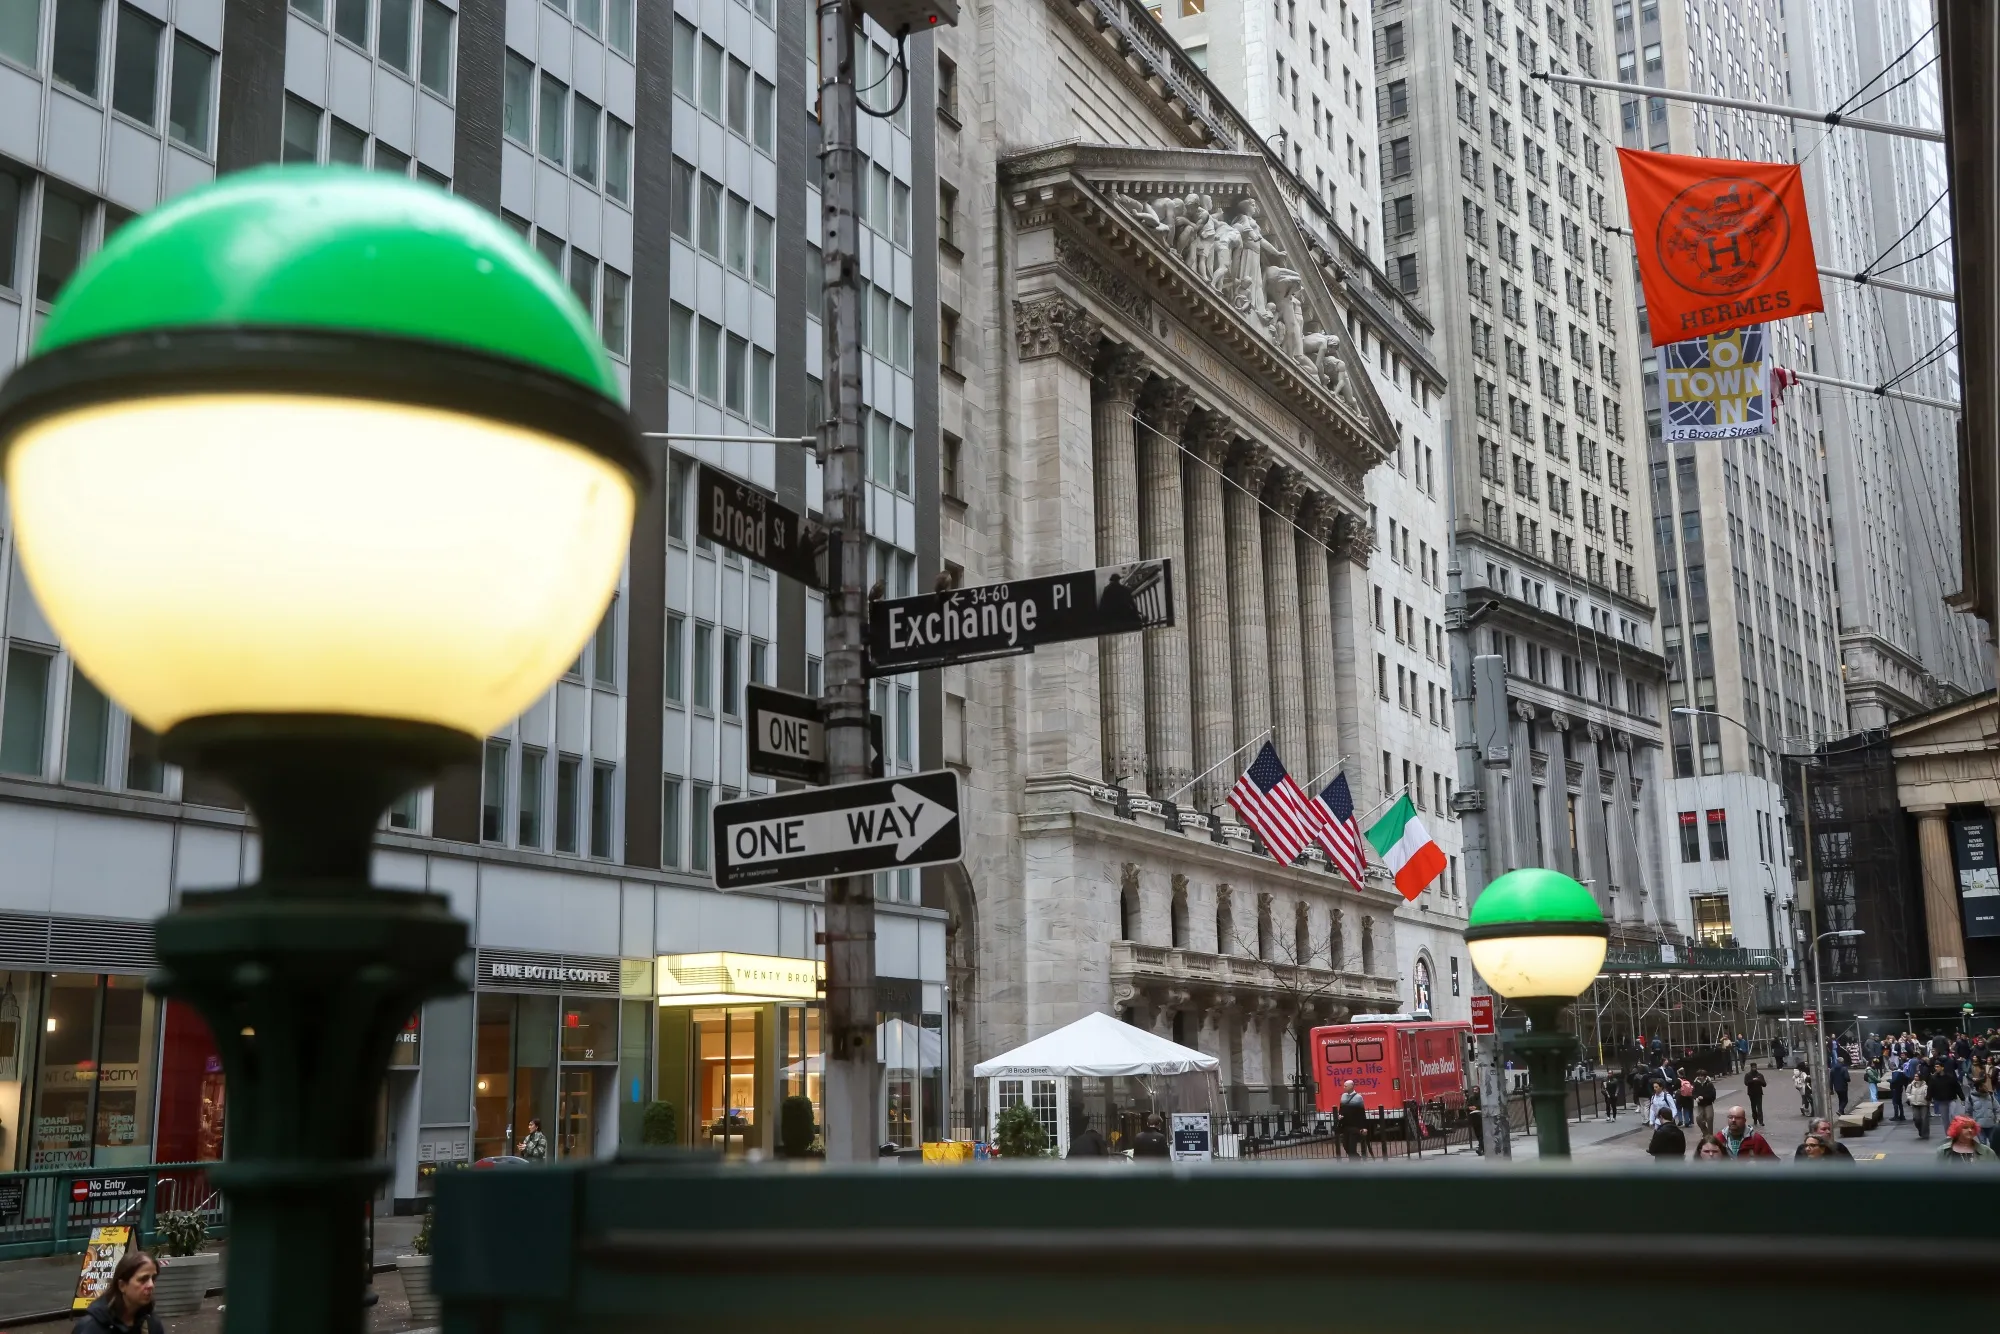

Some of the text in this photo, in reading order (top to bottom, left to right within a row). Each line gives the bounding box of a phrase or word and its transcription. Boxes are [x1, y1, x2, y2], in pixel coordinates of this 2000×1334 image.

[1666, 366, 1762, 397] TOWN
[1671, 424, 1763, 440] 15 Broad Street
[713, 485, 786, 558] Broad St
[971, 584, 1009, 605] 34-60
[889, 583, 1072, 649] Exchange Pl
[770, 717, 810, 756] ONE
[735, 803, 924, 860] ONE WAY
[492, 963, 611, 983] BLUE BOTTLE COFFEE
[737, 969, 780, 980] TWENTY
[585, 1049, 594, 1058] 22
[1326, 1063, 1386, 1076] Save a life.
[1420, 1056, 1455, 1077] Donate Blood
[109, 1070, 139, 1081] CITY
[1354, 1078, 1381, 1088] easy.
[38, 1117, 69, 1125] BOARD
[109, 1115, 134, 1123] OPEN
[38, 1125, 83, 1134] CERTIFIED
[38, 1133, 90, 1142] PHYSICIANS
[45, 1150, 88, 1162] CITYMD
[90, 1180, 126, 1190] No Entry
[86, 1272, 100, 1280] PRIX
[88, 1283, 108, 1291] LUNCH
